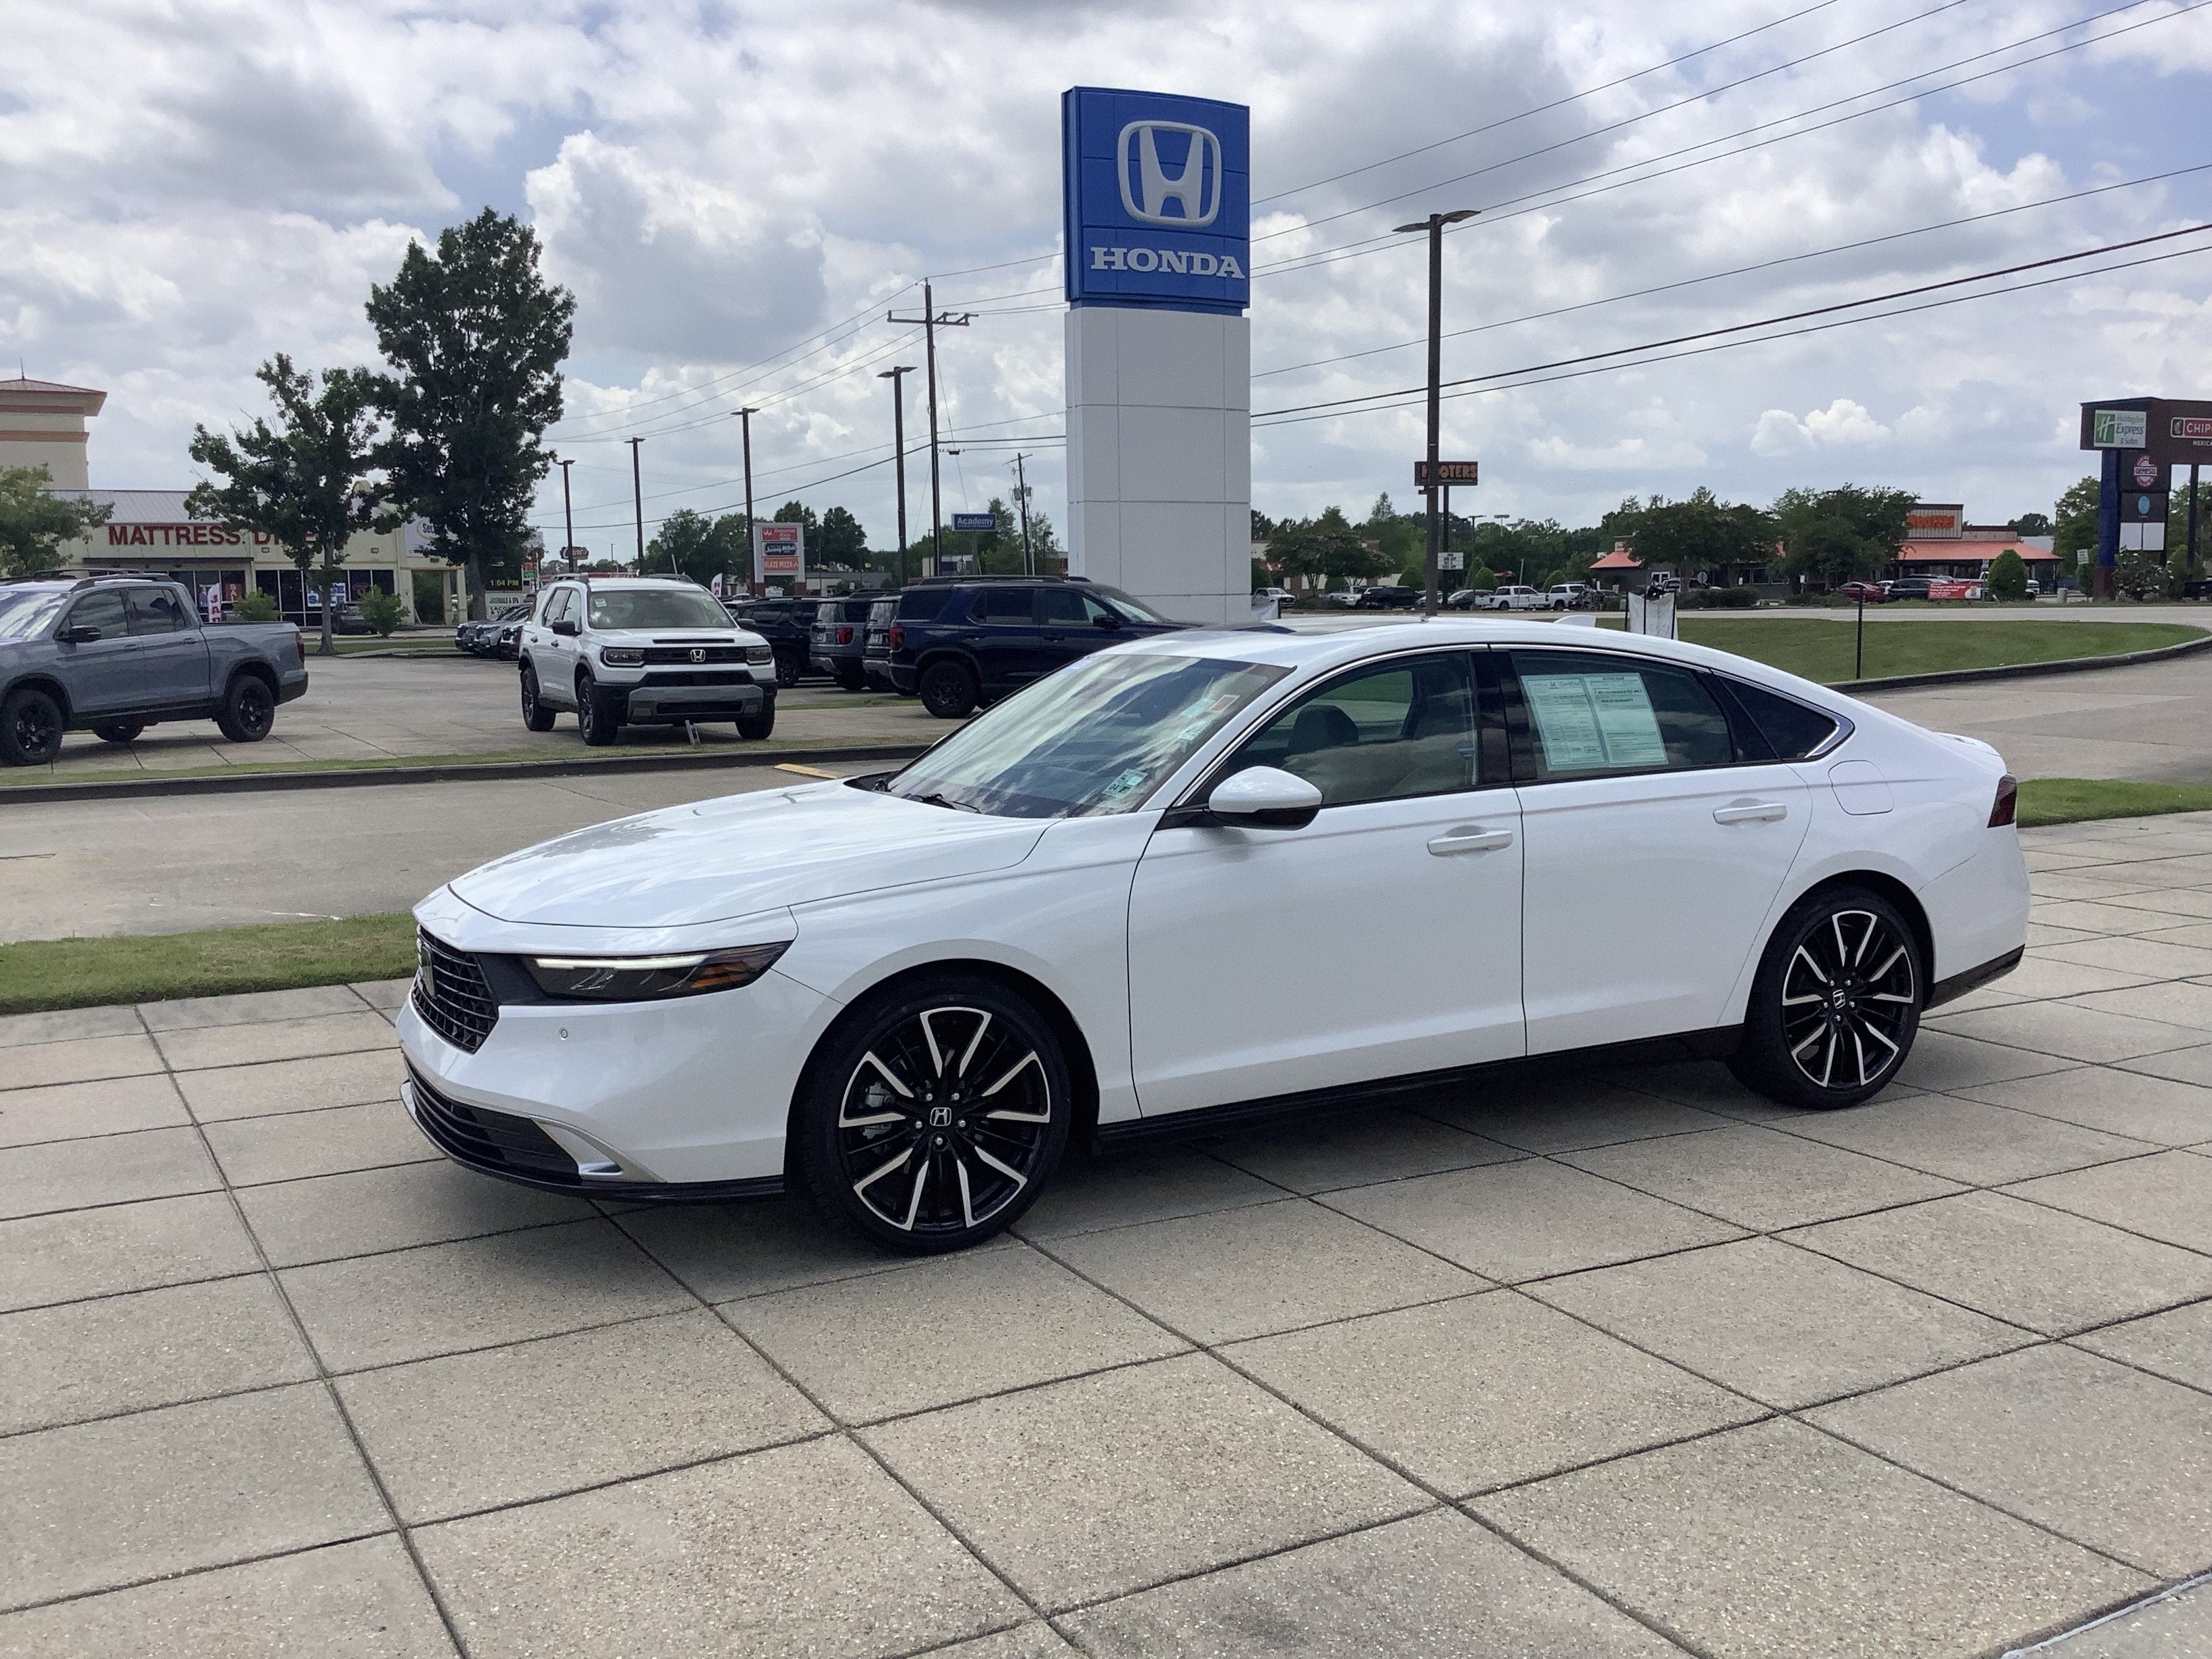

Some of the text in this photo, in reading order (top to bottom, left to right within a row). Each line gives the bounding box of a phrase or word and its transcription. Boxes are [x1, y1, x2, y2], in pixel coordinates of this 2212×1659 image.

[1090, 247, 1246, 279] HONDA
[2116, 423, 2144, 436] Express
[2186, 422, 2212, 434] CHIP
[957, 517, 994, 527] Academy
[108, 525, 241, 546] MATTRESS
